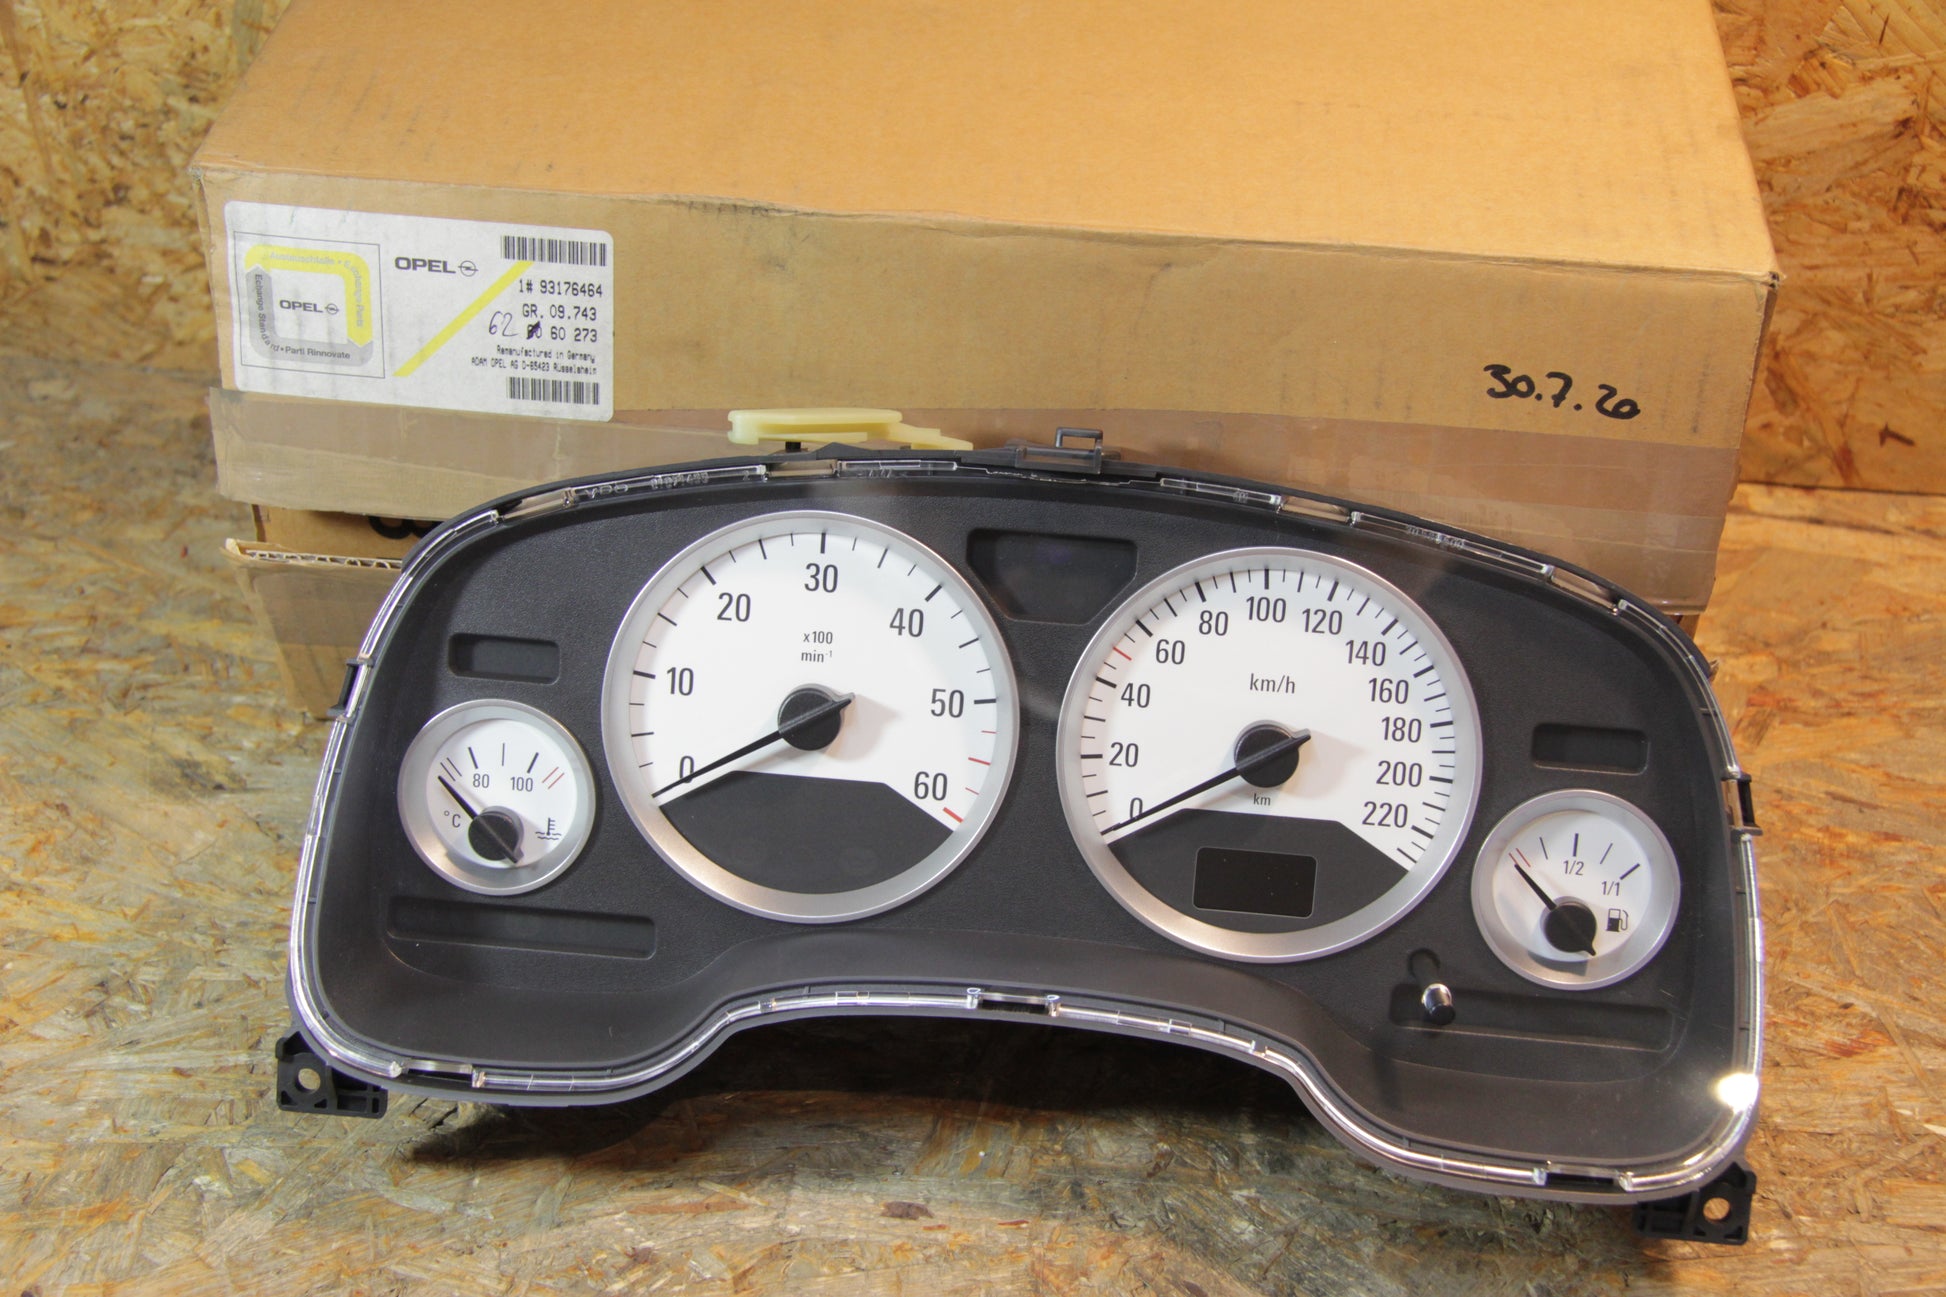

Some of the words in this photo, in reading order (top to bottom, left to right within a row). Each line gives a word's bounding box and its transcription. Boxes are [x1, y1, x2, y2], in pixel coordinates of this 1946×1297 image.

[394, 256, 457, 275] OPEL
[539, 279, 603, 298] 93176464
[279, 299, 324, 314] OPEL
[522, 302, 544, 319] GR.
[549, 303, 597, 322] 09.743
[488, 311, 519, 337] 62
[550, 325, 566, 341] 60
[573, 327, 598, 343] 273
[307, 347, 351, 359] Rinnovate
[490, 358, 507, 369] OPEL
[510, 360, 519, 370] AG
[804, 562, 839, 594] 30
[716, 592, 751, 623] 20
[1245, 595, 1287, 623] 100
[889, 607, 924, 638] 40
[1198, 609, 1229, 637] 80
[1301, 607, 1343, 636] 120
[803, 630, 834, 645] x100
[1155, 638, 1186, 665] 60
[1345, 639, 1387, 667] 140
[666, 666, 694, 697] 10
[1249, 672, 1296, 694] km/h
[1368, 677, 1410, 705] 160
[930, 688, 965, 719] 50
[1120, 682, 1151, 709] 40
[1381, 716, 1423, 744] 180
[1108, 741, 1139, 768] 20
[472, 772, 490, 789] 80
[679, 756, 694, 784] 0
[1375, 760, 1423, 788] 200
[510, 776, 534, 793] 100
[913, 771, 948, 800] 60
[1130, 798, 1143, 820] 0
[1252, 792, 1272, 807] km
[1361, 800, 1409, 829] 220
[1563, 859, 1585, 876] 1/2
[1601, 880, 1620, 897] 1/1
